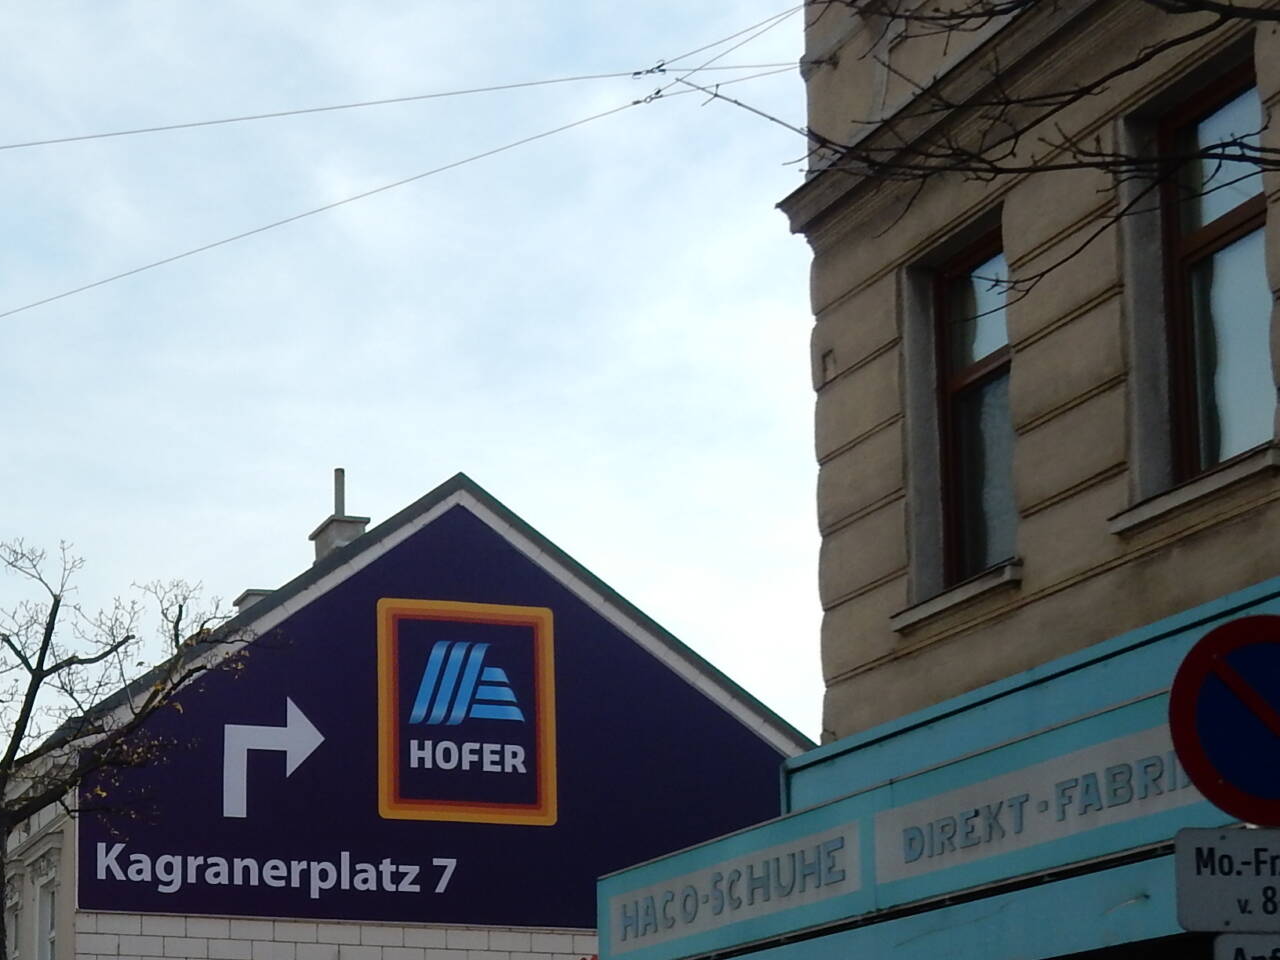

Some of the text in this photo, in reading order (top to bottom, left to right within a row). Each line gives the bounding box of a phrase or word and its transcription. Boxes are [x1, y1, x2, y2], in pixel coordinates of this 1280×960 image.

[410, 739, 527, 773] HOFER
[96, 841, 458, 899] Kagranerplatz 7
